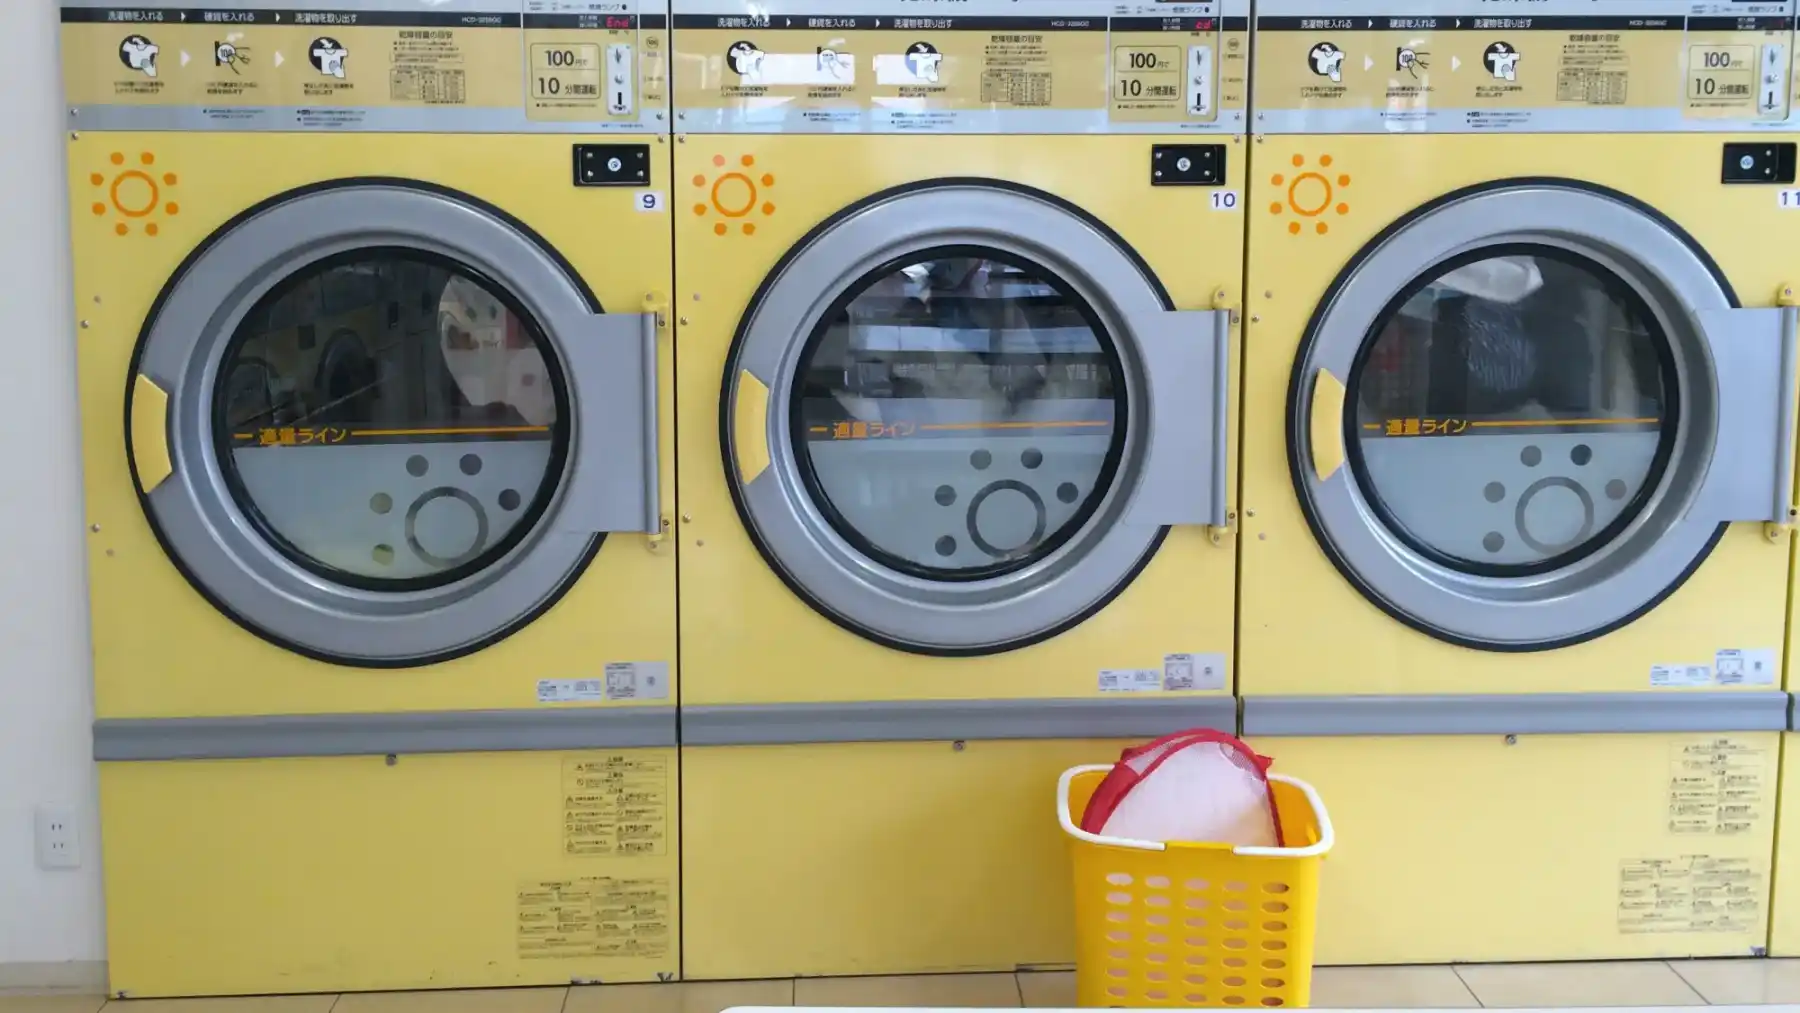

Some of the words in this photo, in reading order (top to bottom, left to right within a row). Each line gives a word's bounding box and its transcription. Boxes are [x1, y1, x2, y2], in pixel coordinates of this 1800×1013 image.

[643, 194, 655, 208] 9
[1213, 193, 1235, 207] 10
[259, 427, 346, 445] 適量ライン
[833, 421, 915, 439] 適量ライン
[1386, 418, 1467, 436] 適量ライン
